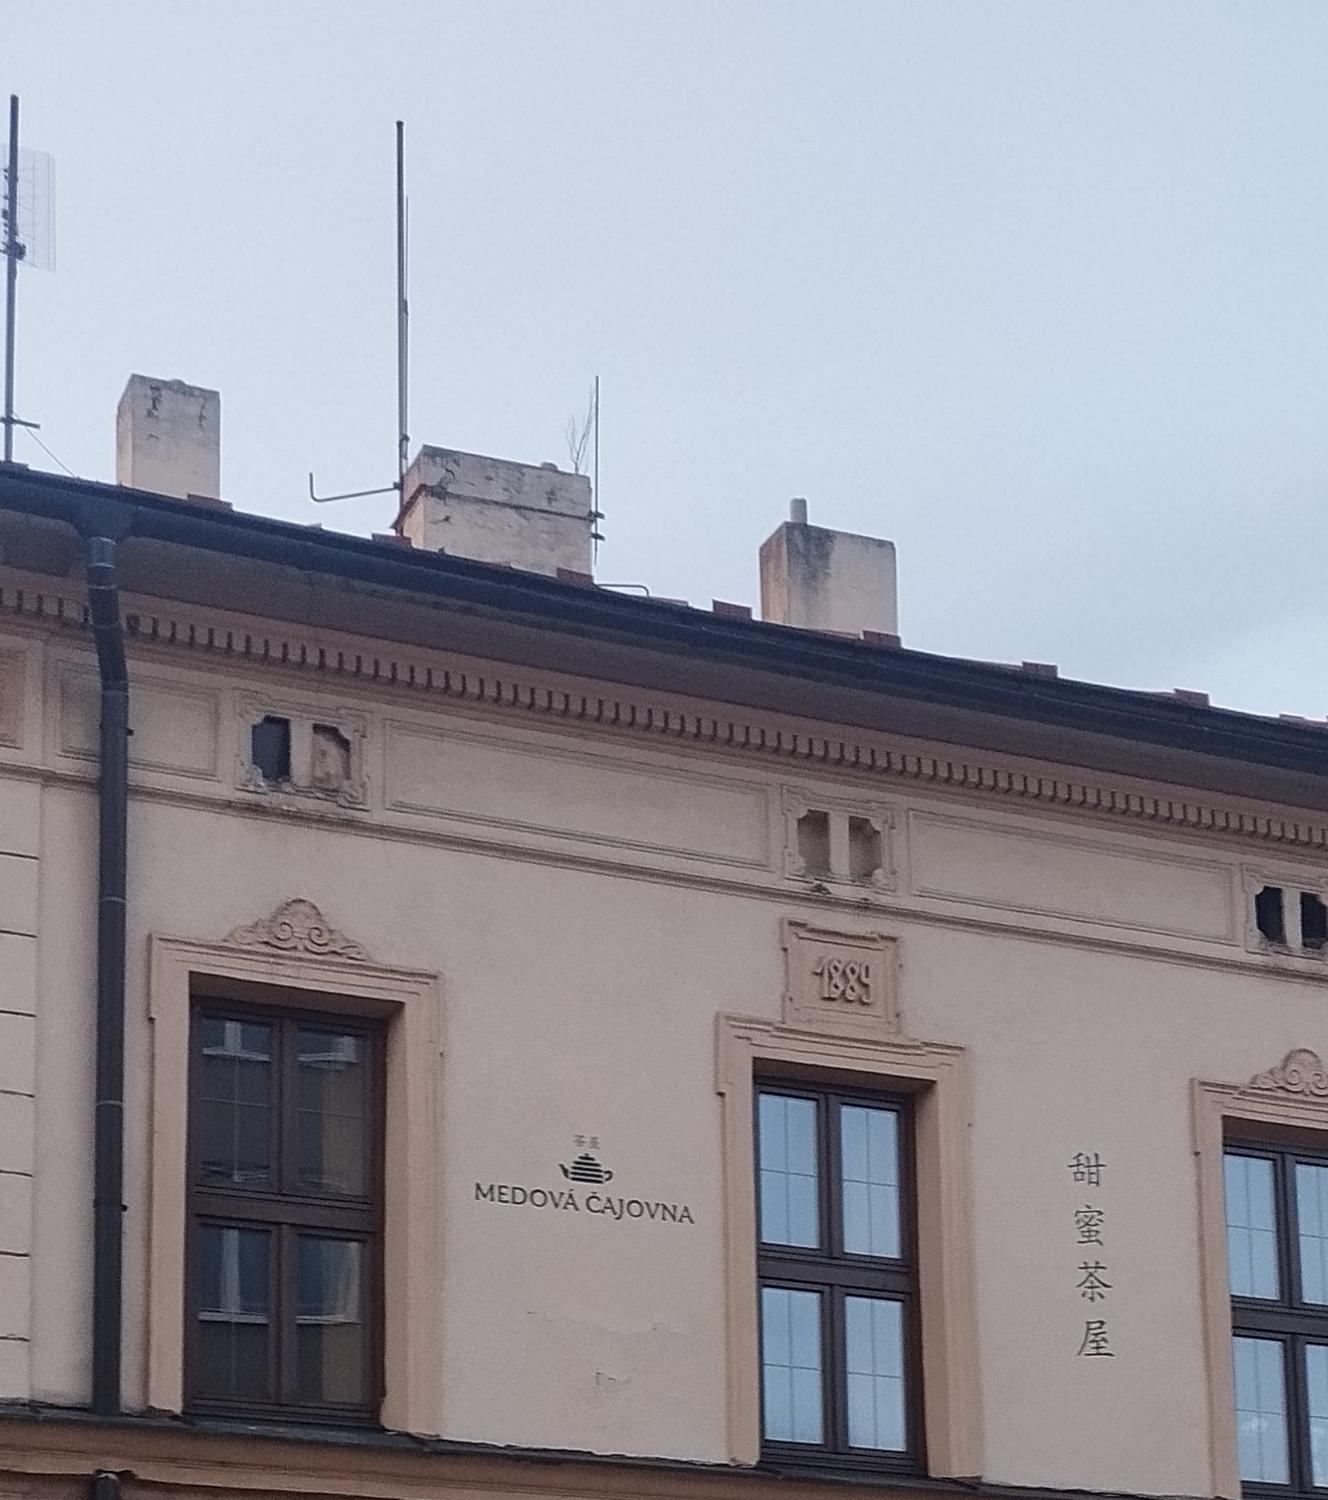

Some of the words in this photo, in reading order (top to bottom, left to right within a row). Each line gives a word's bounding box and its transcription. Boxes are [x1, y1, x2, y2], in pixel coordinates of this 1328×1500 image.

[811, 957, 873, 1005] 1889
[475, 1182, 580, 1212] MEDOVÁ
[586, 1191, 695, 1225] ČAJOVNA
[1067, 1152, 1116, 1358] 甜蜜茶屋
